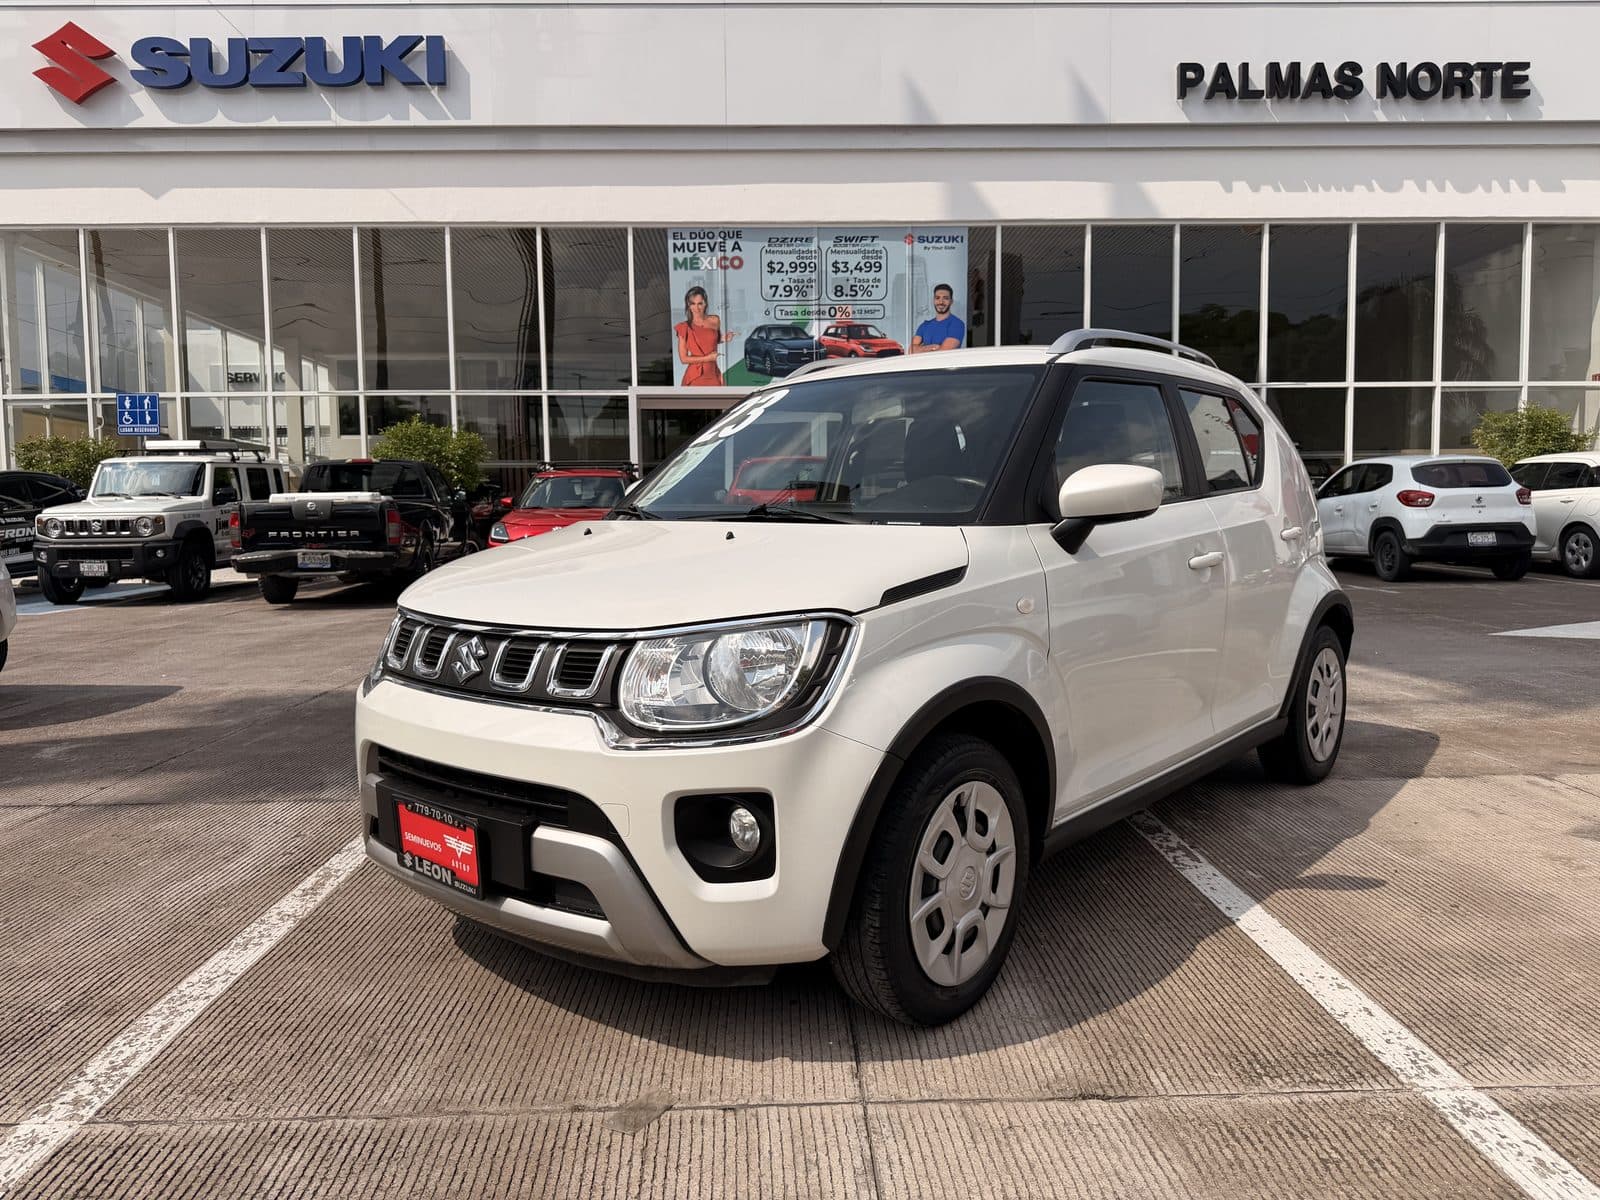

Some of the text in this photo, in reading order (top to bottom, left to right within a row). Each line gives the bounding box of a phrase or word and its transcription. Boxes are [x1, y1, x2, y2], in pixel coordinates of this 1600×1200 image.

[130, 35, 447, 89] SUZUKI
[1176, 61, 1531, 101] PALMAS NORTE
[672, 229, 743, 241] EL DÚO QUE
[833, 235, 880, 243] SWIFT
[917, 235, 964, 244] SUZUKI
[672, 240, 743, 253] MUEVE A
[765, 248, 817, 256] Mensualidades
[830, 248, 883, 256] Mensualidades
[672, 253, 744, 271] MÉXICO
[767, 261, 817, 275] $2,999
[831, 260, 883, 275] $3,499
[800, 308, 827, 316] desde
[828, 306, 851, 318] 0%
[268, 530, 360, 538] FRONTIER
[404, 831, 442, 853] SEMINUEVOS
[414, 856, 452, 885] LEON
